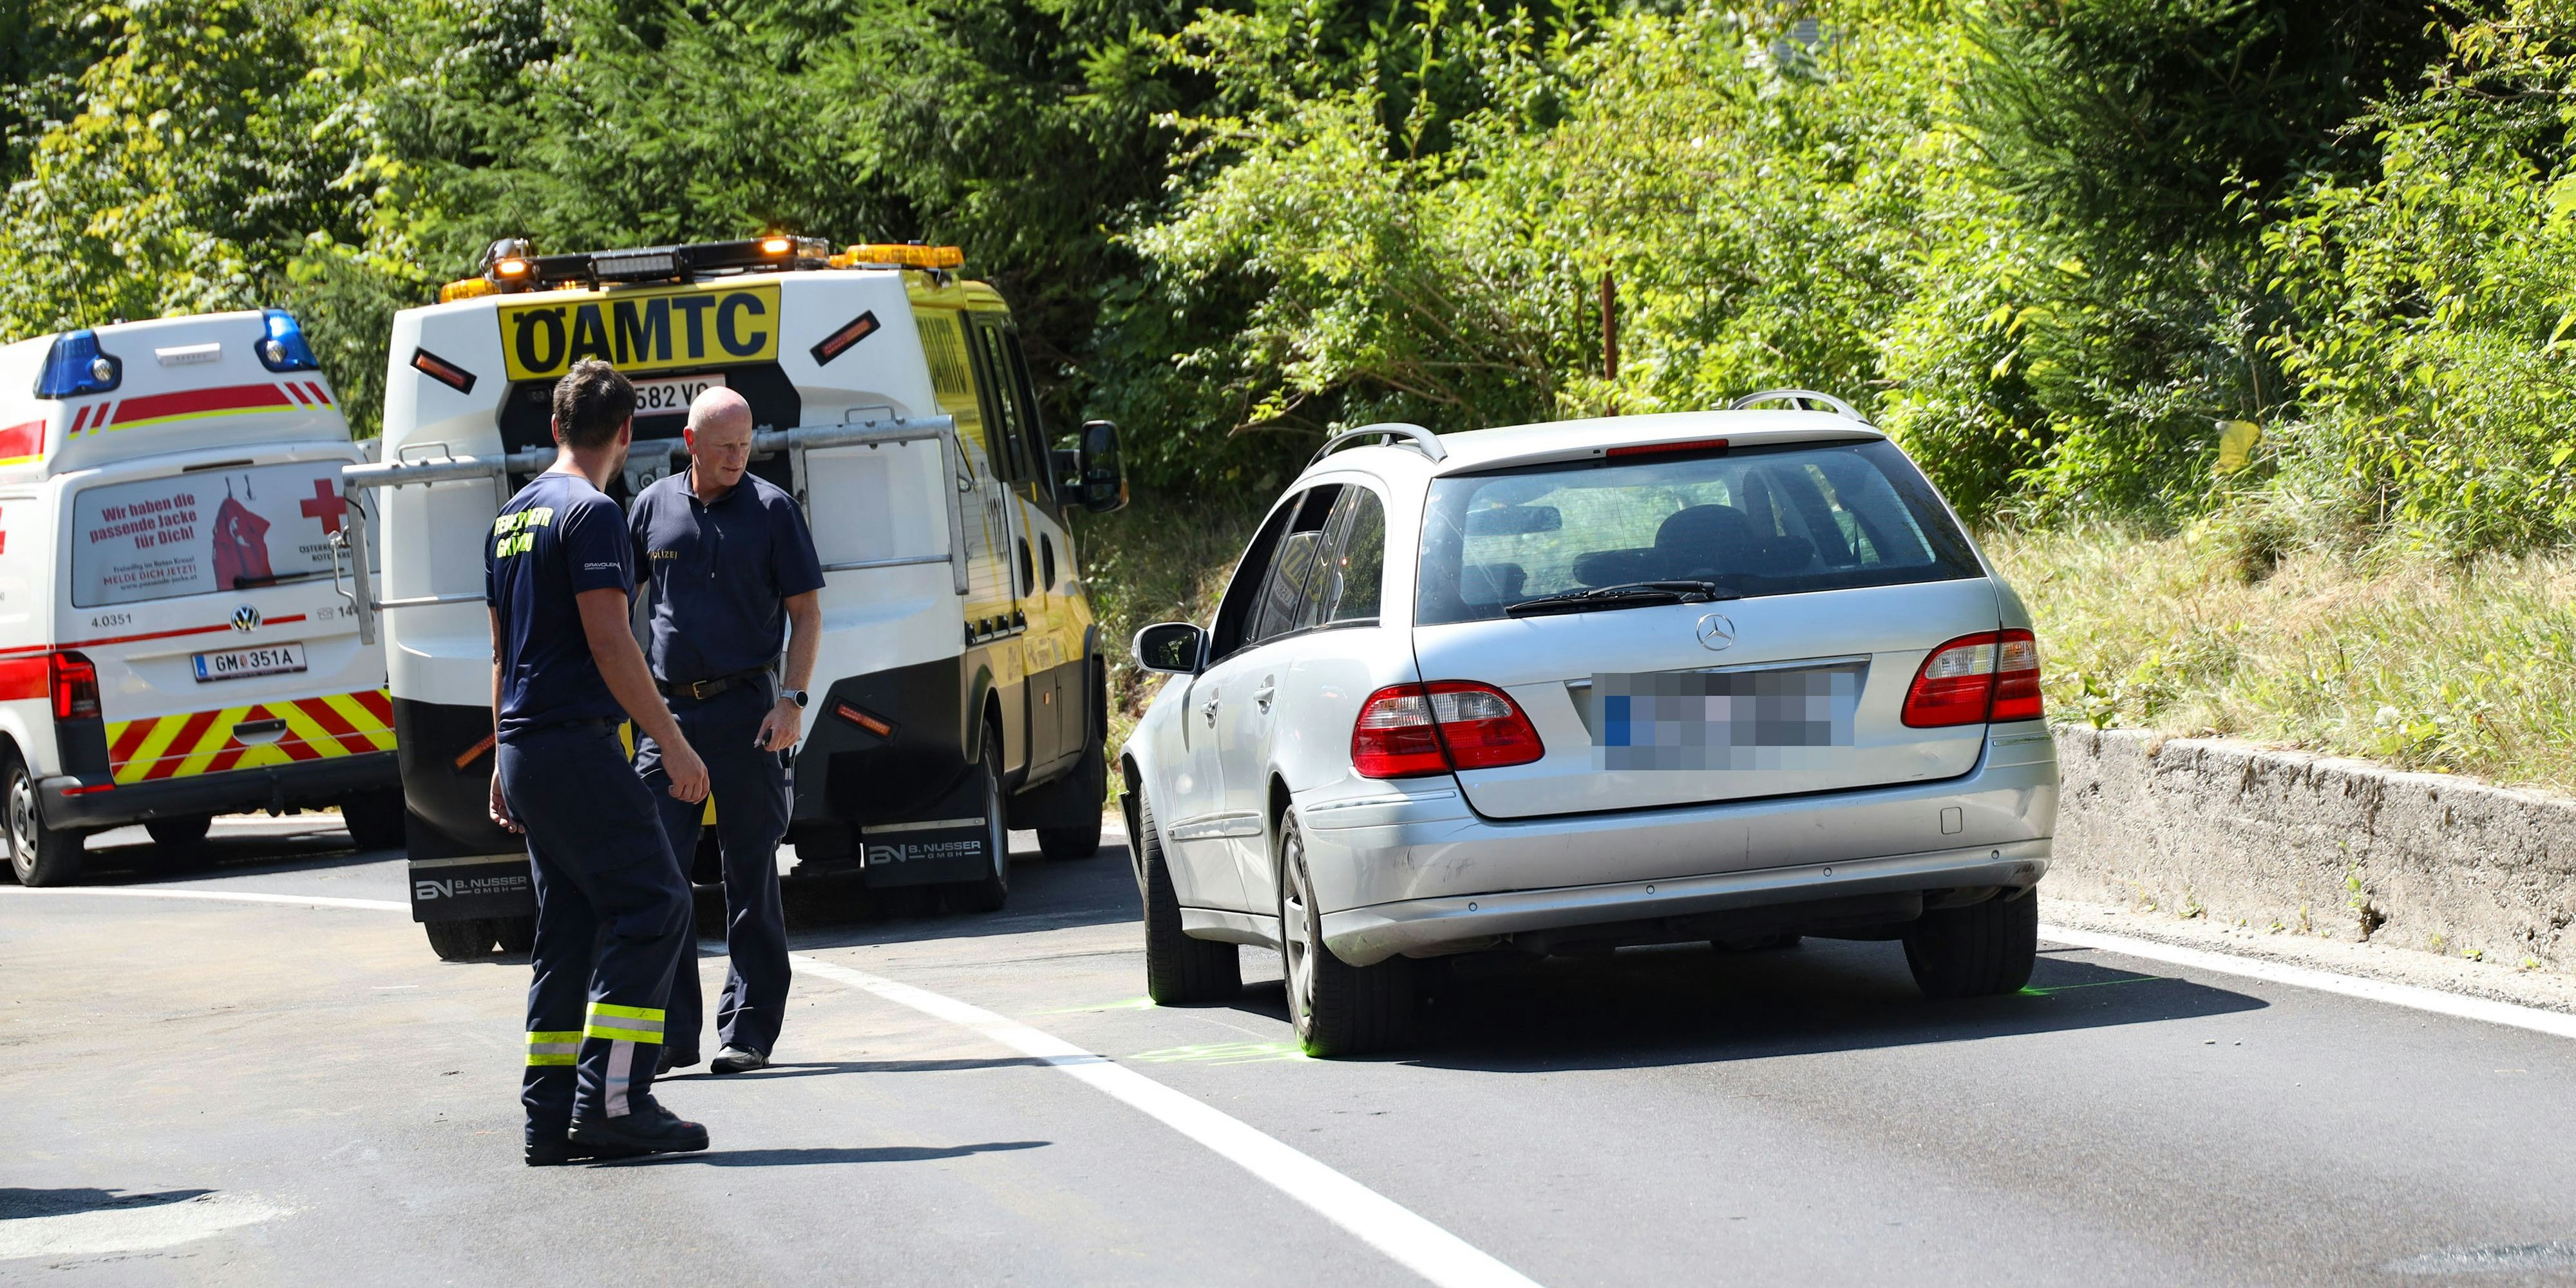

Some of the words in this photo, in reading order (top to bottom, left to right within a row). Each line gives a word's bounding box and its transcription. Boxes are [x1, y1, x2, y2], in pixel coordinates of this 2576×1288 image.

[513, 292, 767, 374] ÖAMTC
[636, 385, 676, 410] 582
[102, 506, 126, 522] Wir
[129, 498, 172, 516] haben
[173, 493, 195, 507] die
[89, 517, 156, 544] passende
[158, 510, 197, 528] Jacke
[134, 533, 155, 549] für
[157, 525, 195, 545] Dich!
[312, 553, 332, 561] ROTE
[104, 571, 137, 585] MELDE
[139, 569, 164, 580] DICH
[167, 564, 196, 576] JETZT!
[91, 613, 131, 627] 4.0351
[338, 606, 354, 617] 14
[215, 653, 239, 672] GM
[250, 648, 293, 667] 351A
[909, 844, 921, 853] B.
[924, 840, 981, 852] NUSSER
[455, 880, 468, 888] B.
[471, 876, 527, 887] NUSSER
